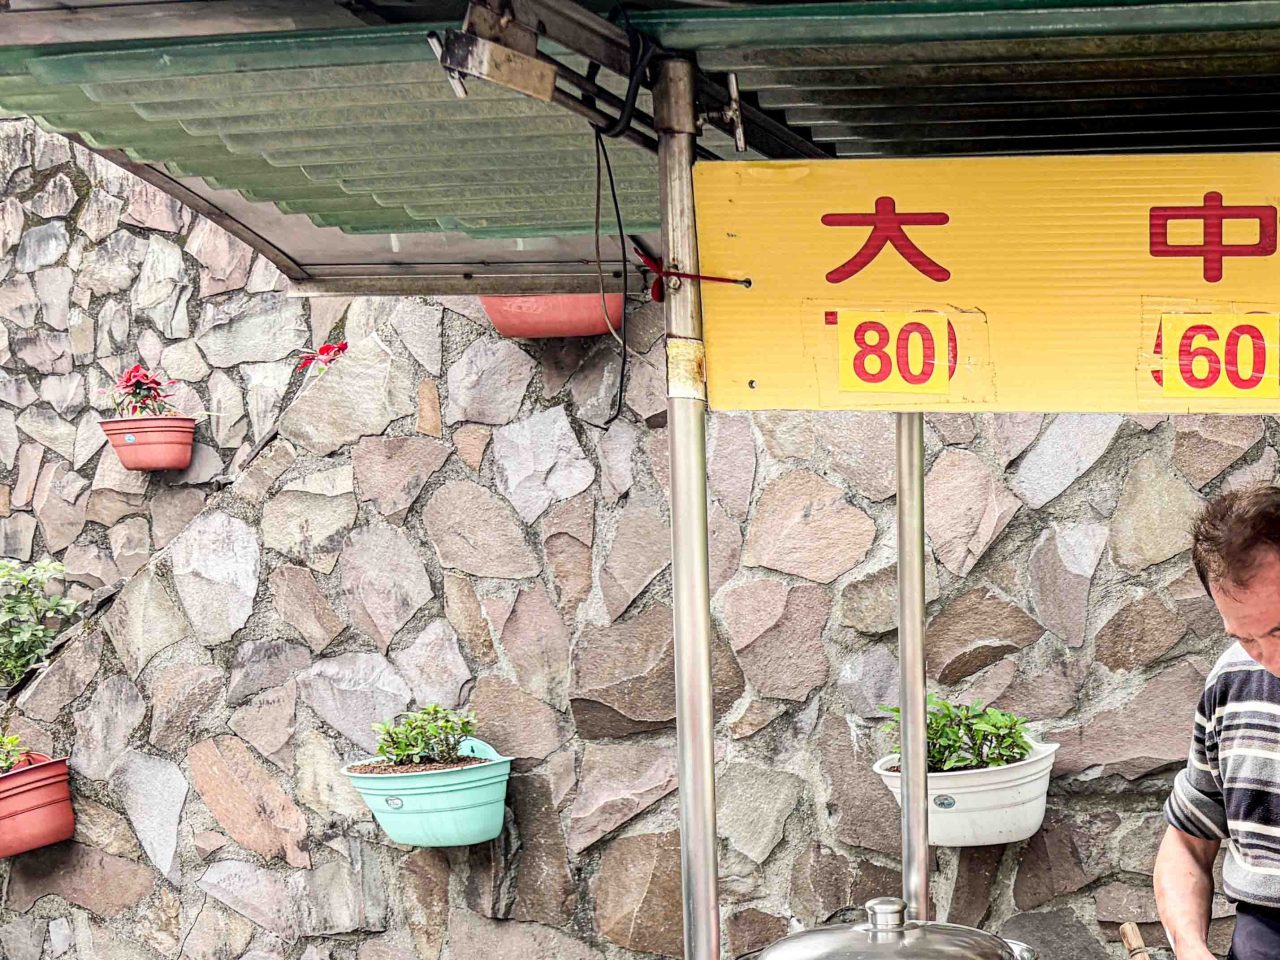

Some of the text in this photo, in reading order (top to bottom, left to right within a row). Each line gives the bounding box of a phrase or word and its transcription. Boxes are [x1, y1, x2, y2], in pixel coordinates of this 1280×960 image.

[821, 196, 951, 284] 大
[1149, 191, 1278, 283] 中
[853, 321, 935, 385] 80
[1178, 324, 1266, 389] 60
